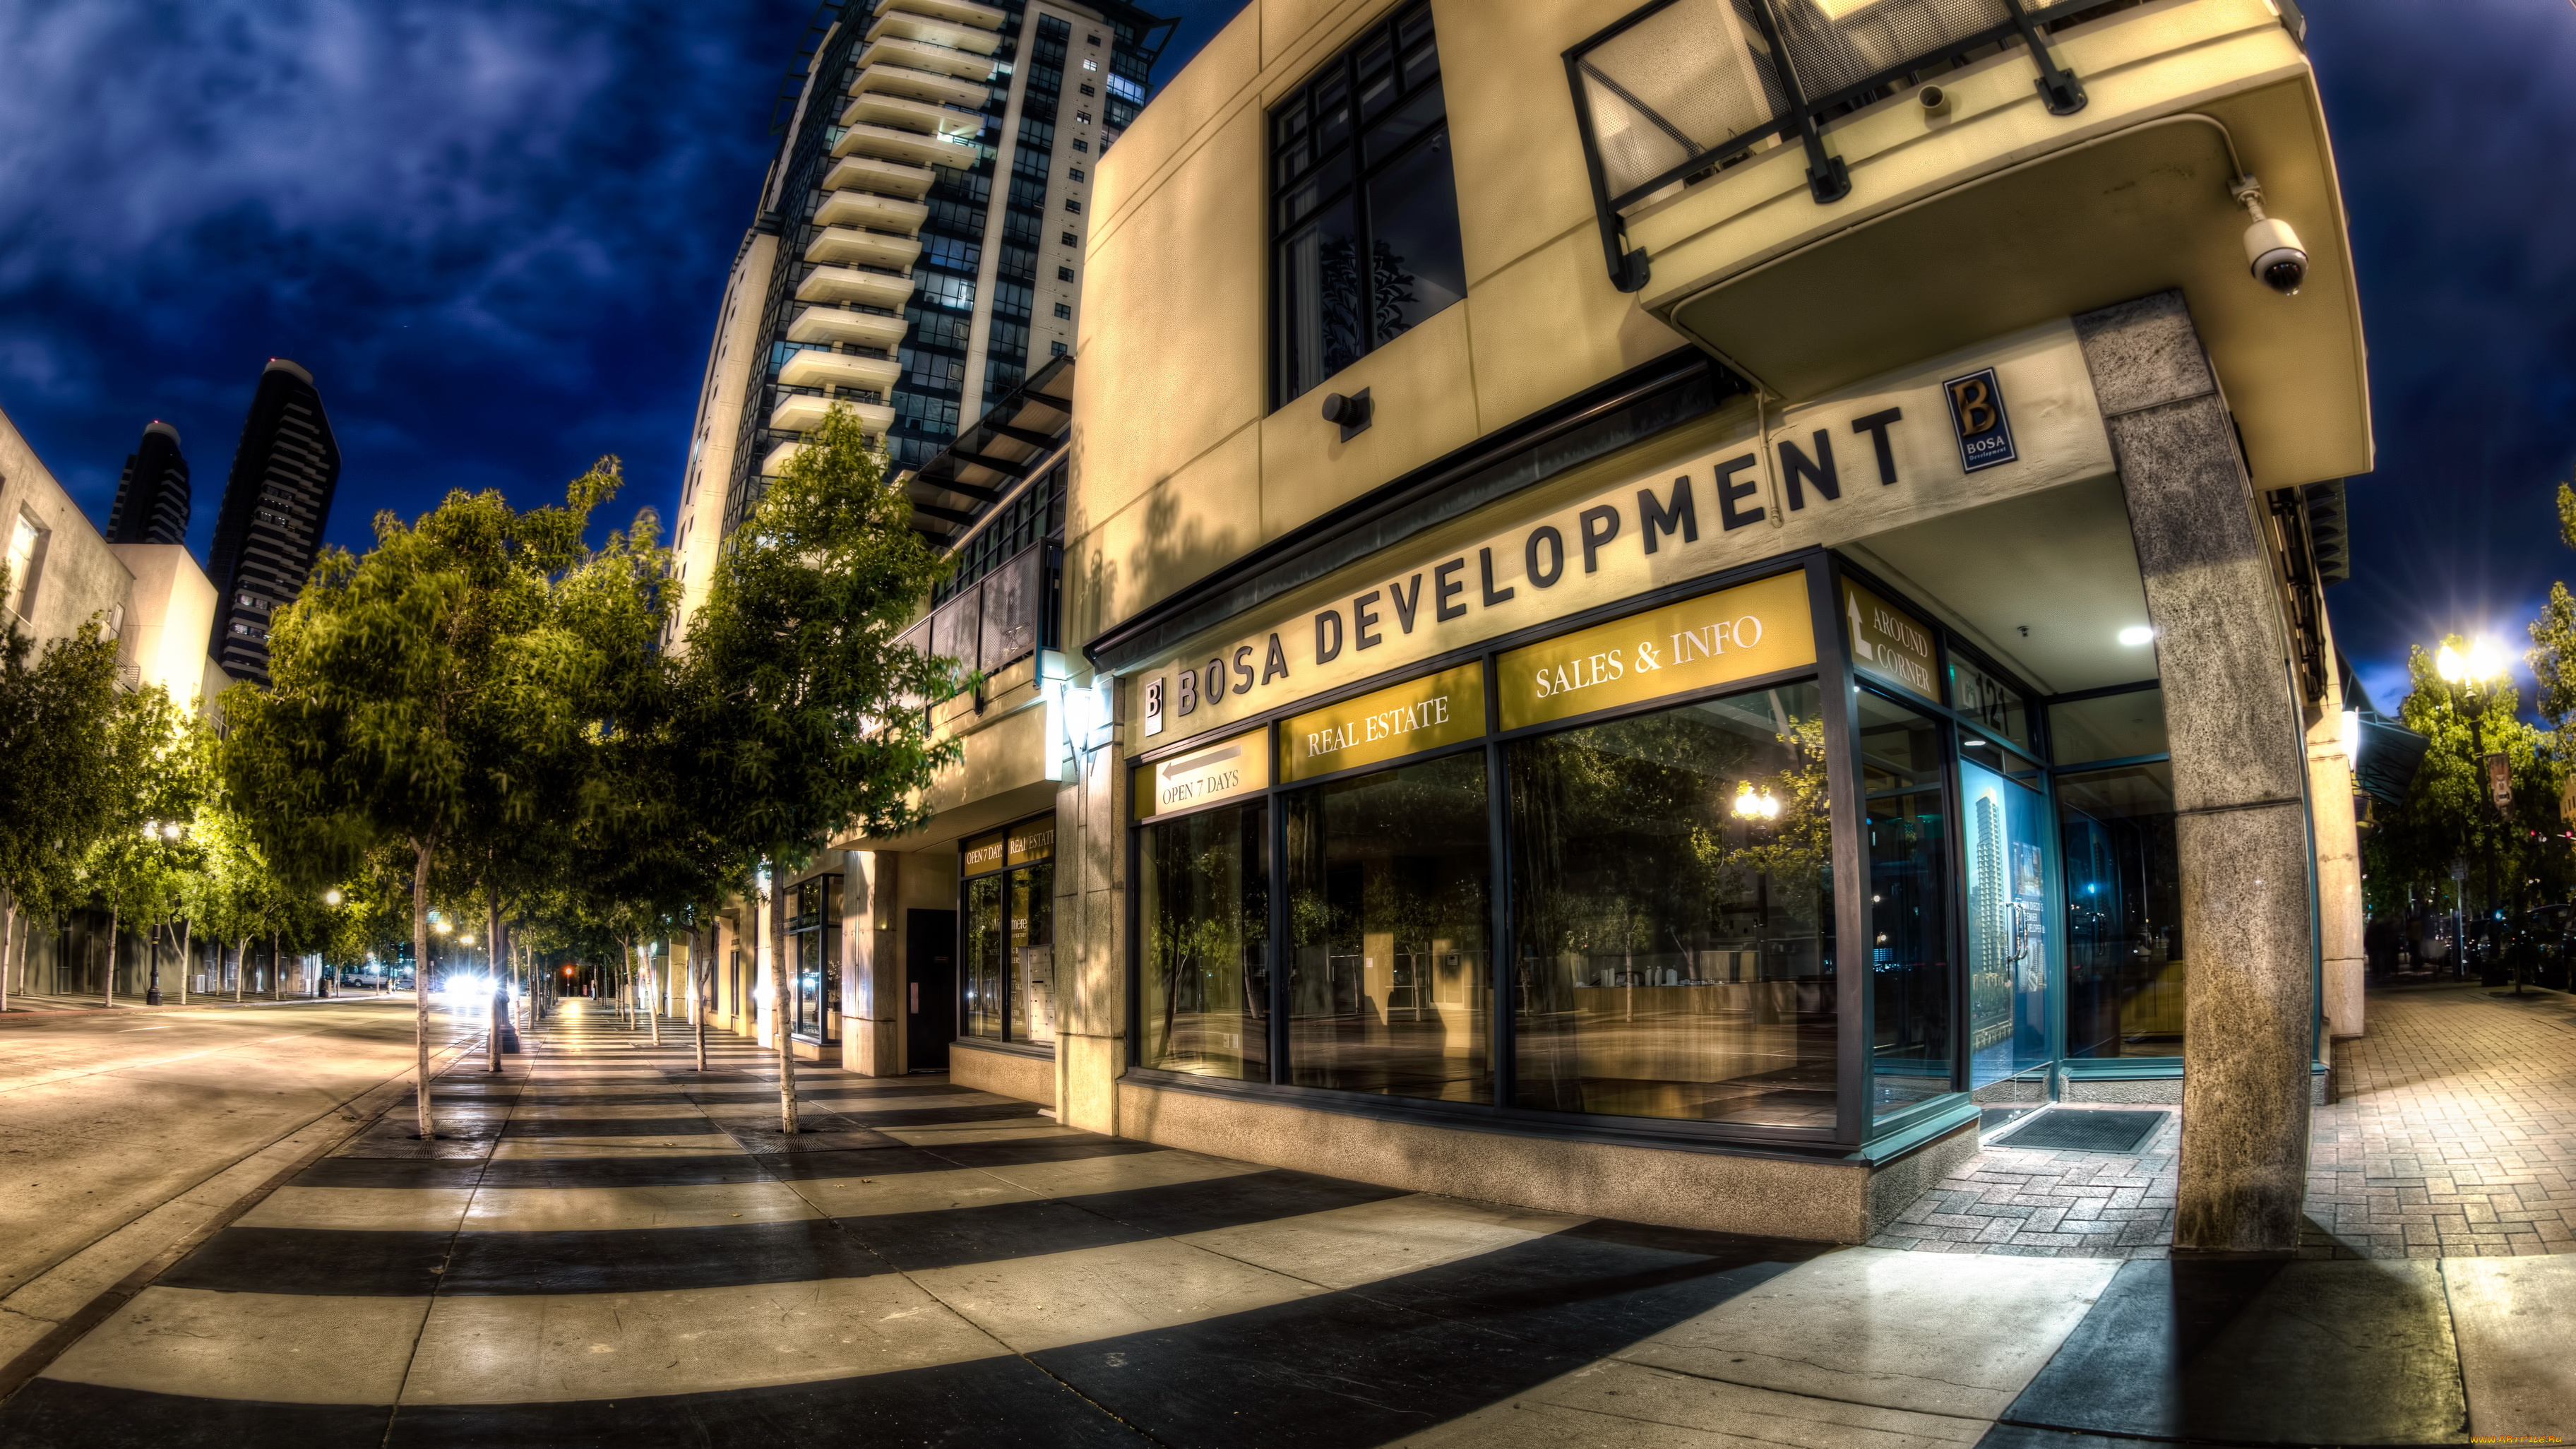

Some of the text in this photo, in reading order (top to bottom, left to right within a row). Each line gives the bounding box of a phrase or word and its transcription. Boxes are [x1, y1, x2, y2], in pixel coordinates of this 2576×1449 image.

[1950, 379, 1996, 437] B
[1967, 436, 2005, 454] BOSA
[1969, 446, 2006, 461] Development
[1178, 407, 1903, 717] BOSA DEVELOPMENT
[1536, 615, 1763, 698] SALES & INFO
[1873, 607, 1928, 657] AROUND
[1878, 643, 1931, 692] CORNER
[1147, 685, 1162, 718] B
[1976, 672, 2009, 737] 121
[1307, 696, 1449, 758] REAL ESTATE
[1162, 769, 1239, 804] OPEN 7 DAYS
[967, 849, 983, 865] OPEN
[984, 849, 988, 861] 7
[1010, 837, 1027, 854] REAL
[1029, 830, 1054, 849] ESTATE
